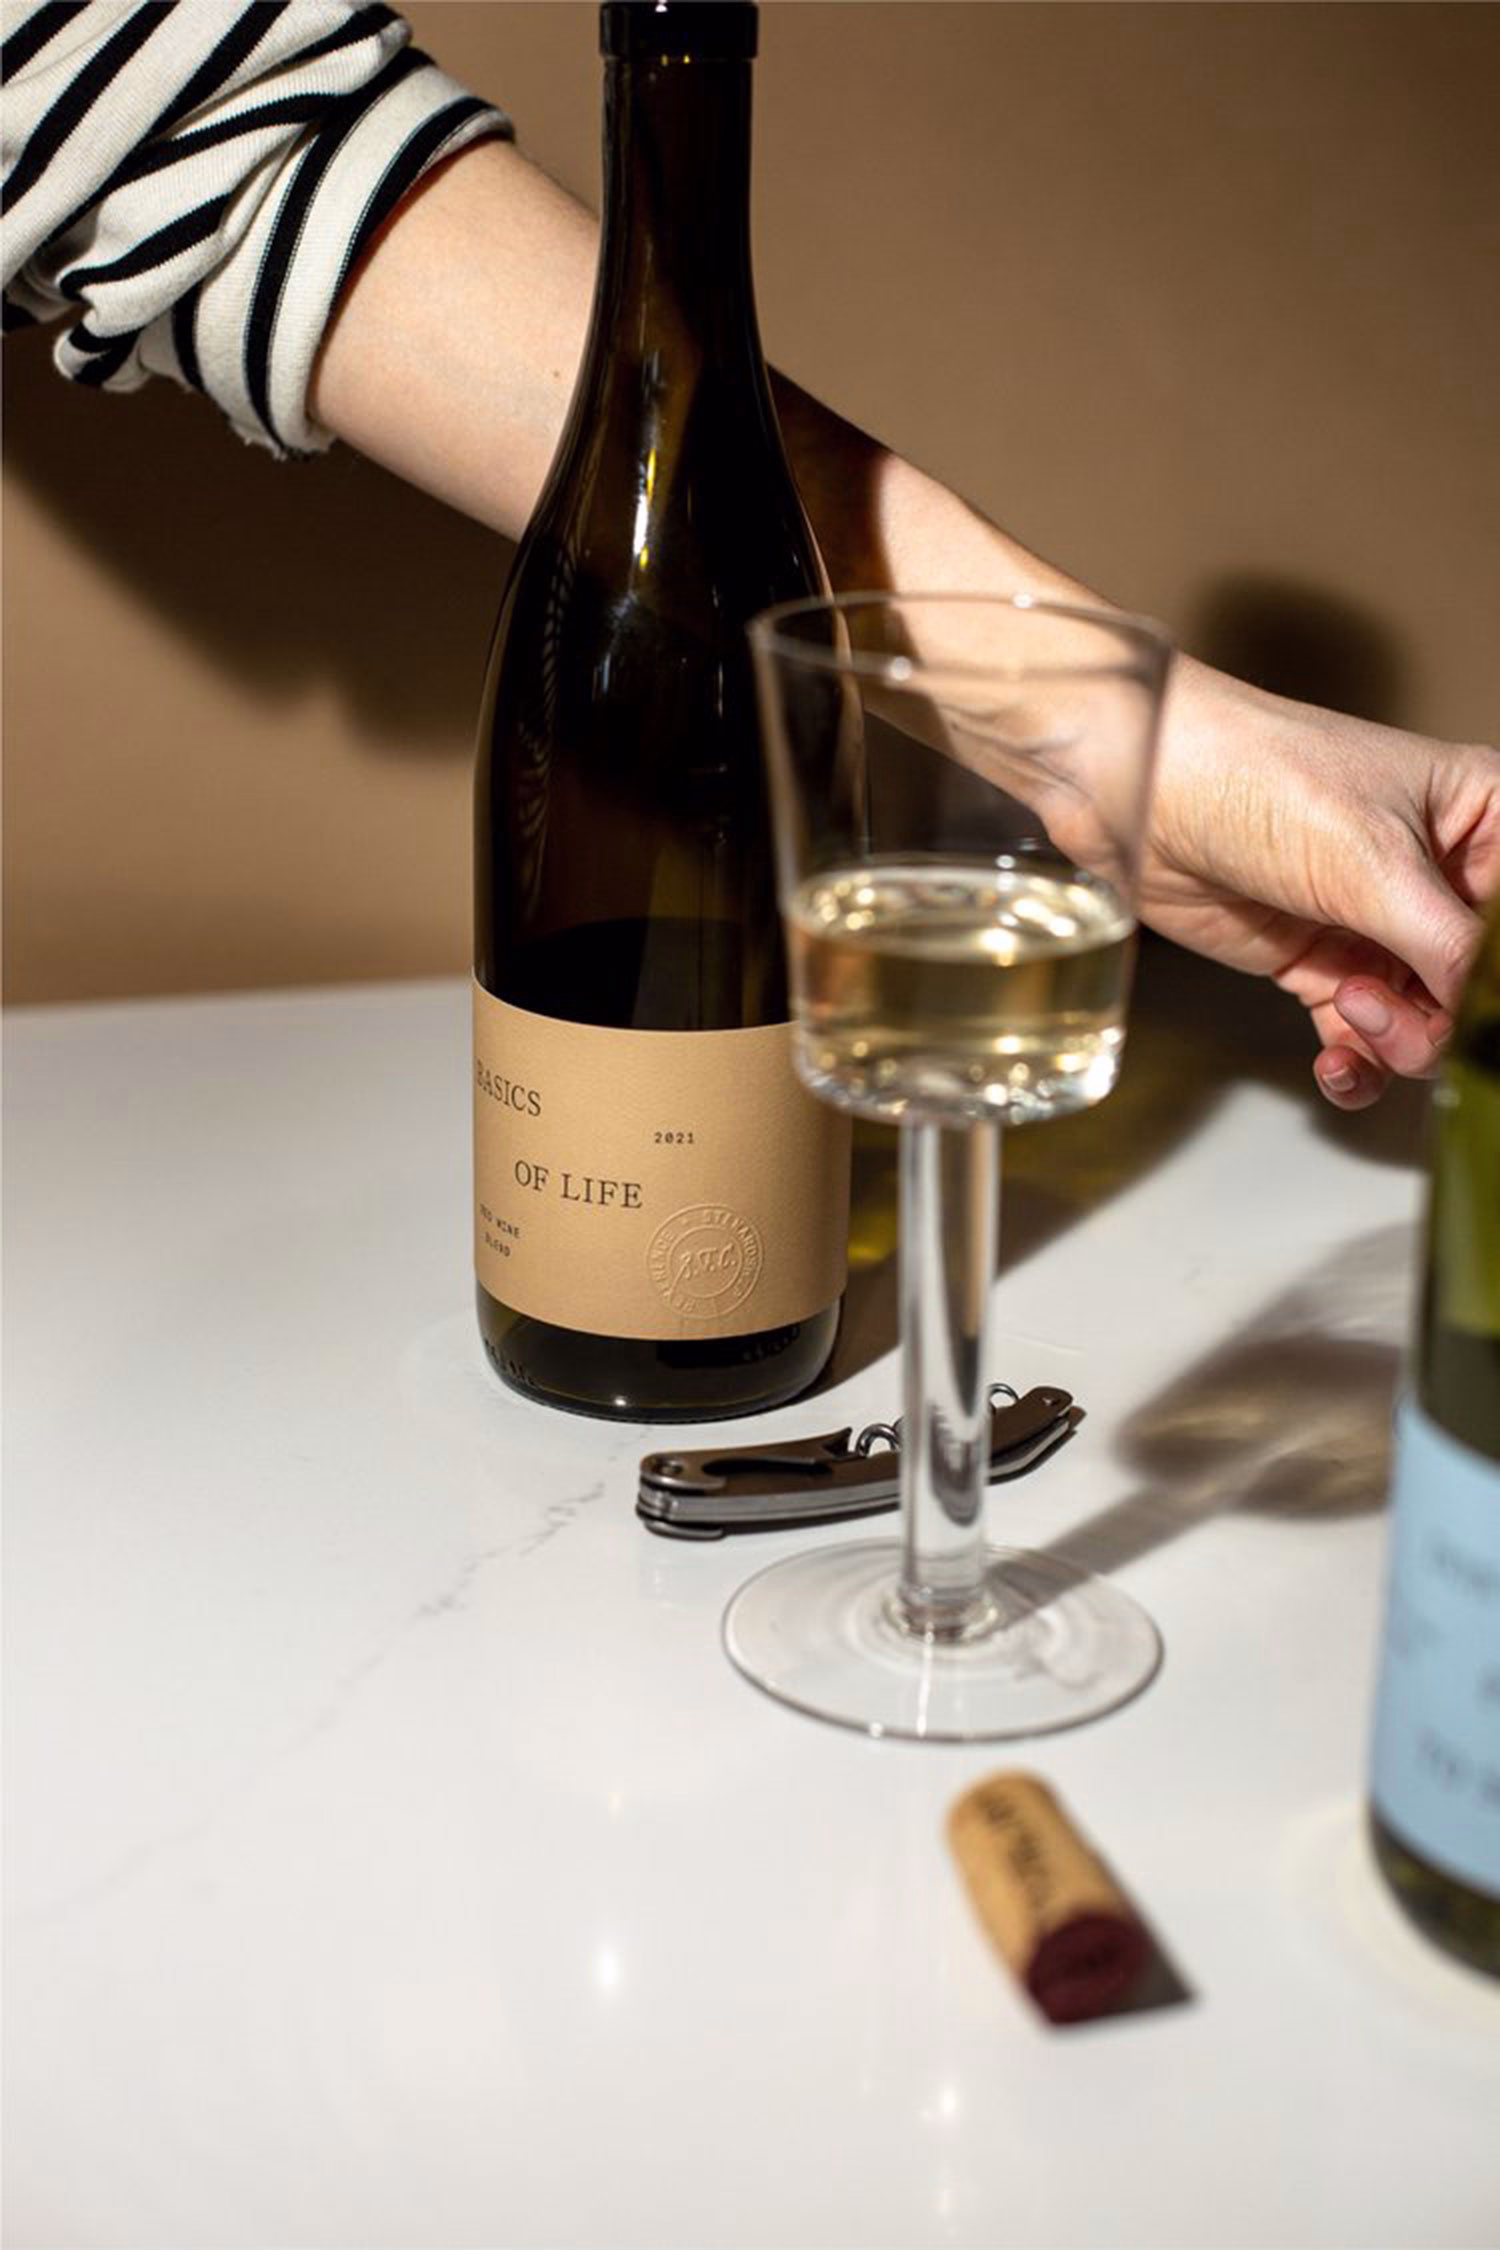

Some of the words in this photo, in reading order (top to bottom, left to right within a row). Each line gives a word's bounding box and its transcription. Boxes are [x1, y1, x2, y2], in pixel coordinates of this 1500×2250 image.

[477, 1058, 542, 1117] BASICS
[653, 1131, 694, 1145] 2021
[514, 1159, 549, 1193] OF
[560, 1172, 643, 1209] LIFE
